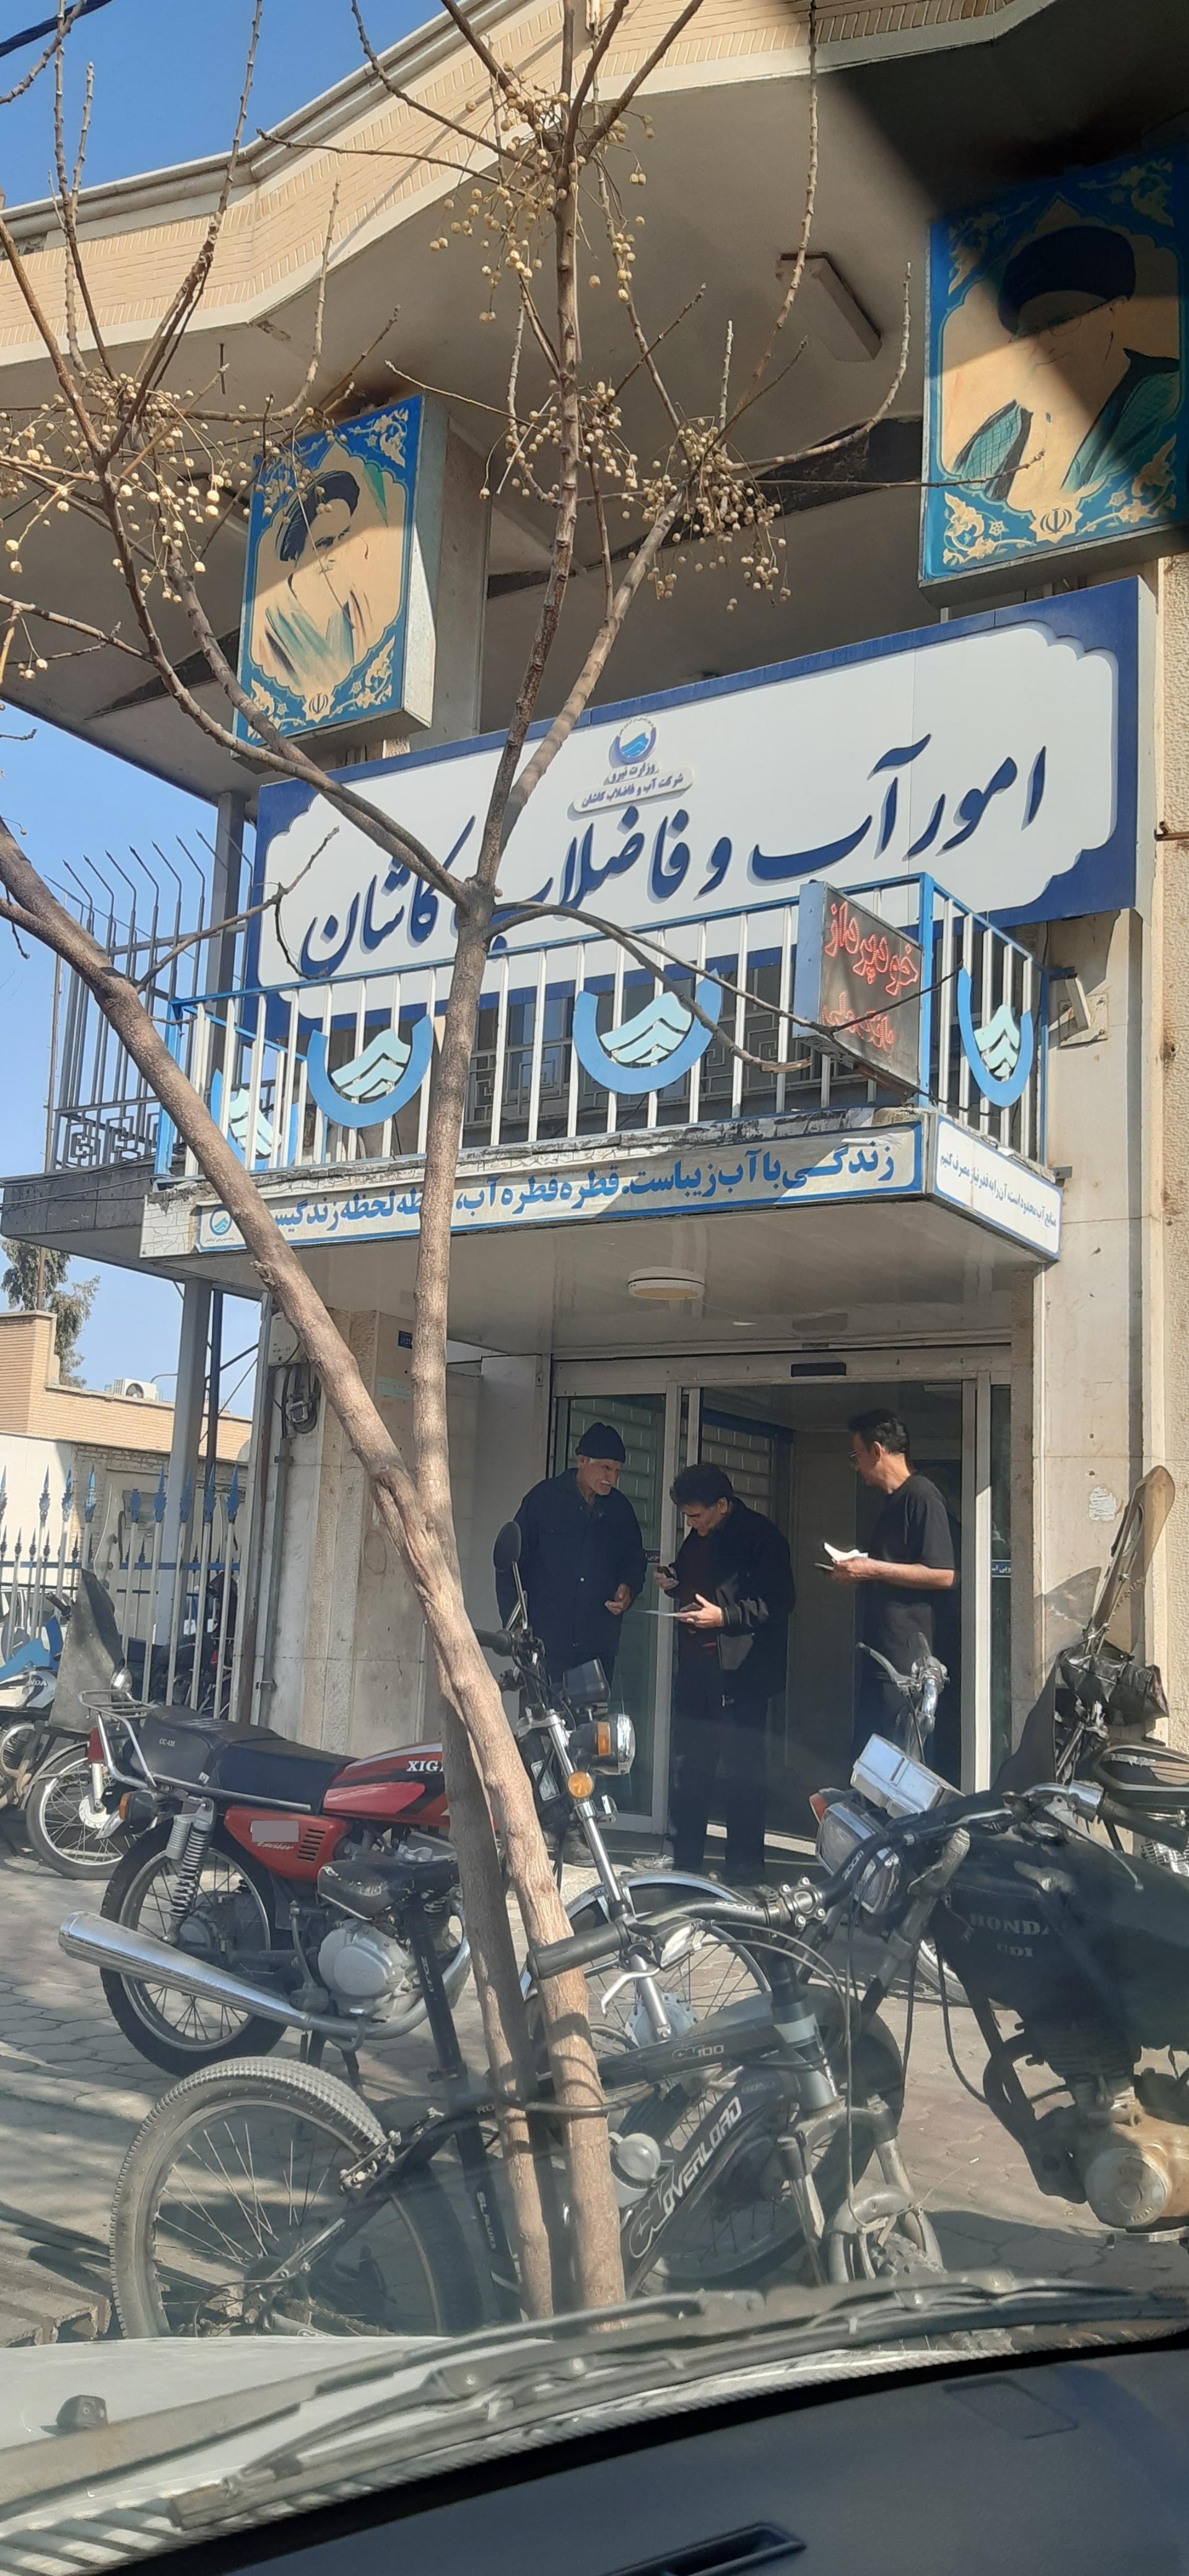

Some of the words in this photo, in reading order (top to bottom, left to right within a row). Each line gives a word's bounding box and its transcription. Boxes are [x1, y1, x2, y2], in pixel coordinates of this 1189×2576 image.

[609, 766, 627, 784] نیرو
[629, 762, 656, 777] وزارت
[643, 778, 658, 792] آب
[658, 773, 684, 789] شرکت
[581, 791, 607, 808] کاشان
[606, 783, 635, 802] فاضلاب
[636, 787, 642, 797] و
[752, 734, 932, 880] آب
[907, 745, 1047, 858] امور
[457, 805, 690, 950] فاضلاب
[696, 836, 733, 896] و
[299, 814, 476, 979] کاشان
[825, 901, 920, 996] خودپرداز
[717, 1148, 762, 1193] آب
[762, 1150, 782, 1189] با
[782, 1141, 895, 1189] زندگی
[340, 1189, 396, 1221] لحظه
[396, 1186, 422, 1216] ظه
[501, 1171, 559, 1215] قطره
[559, 1165, 620, 1209] قطره
[275, 1196, 339, 1232] زندگیس
[1036, 1205, 1046, 1222] آب
[476, 2105, 494, 2114] RO
